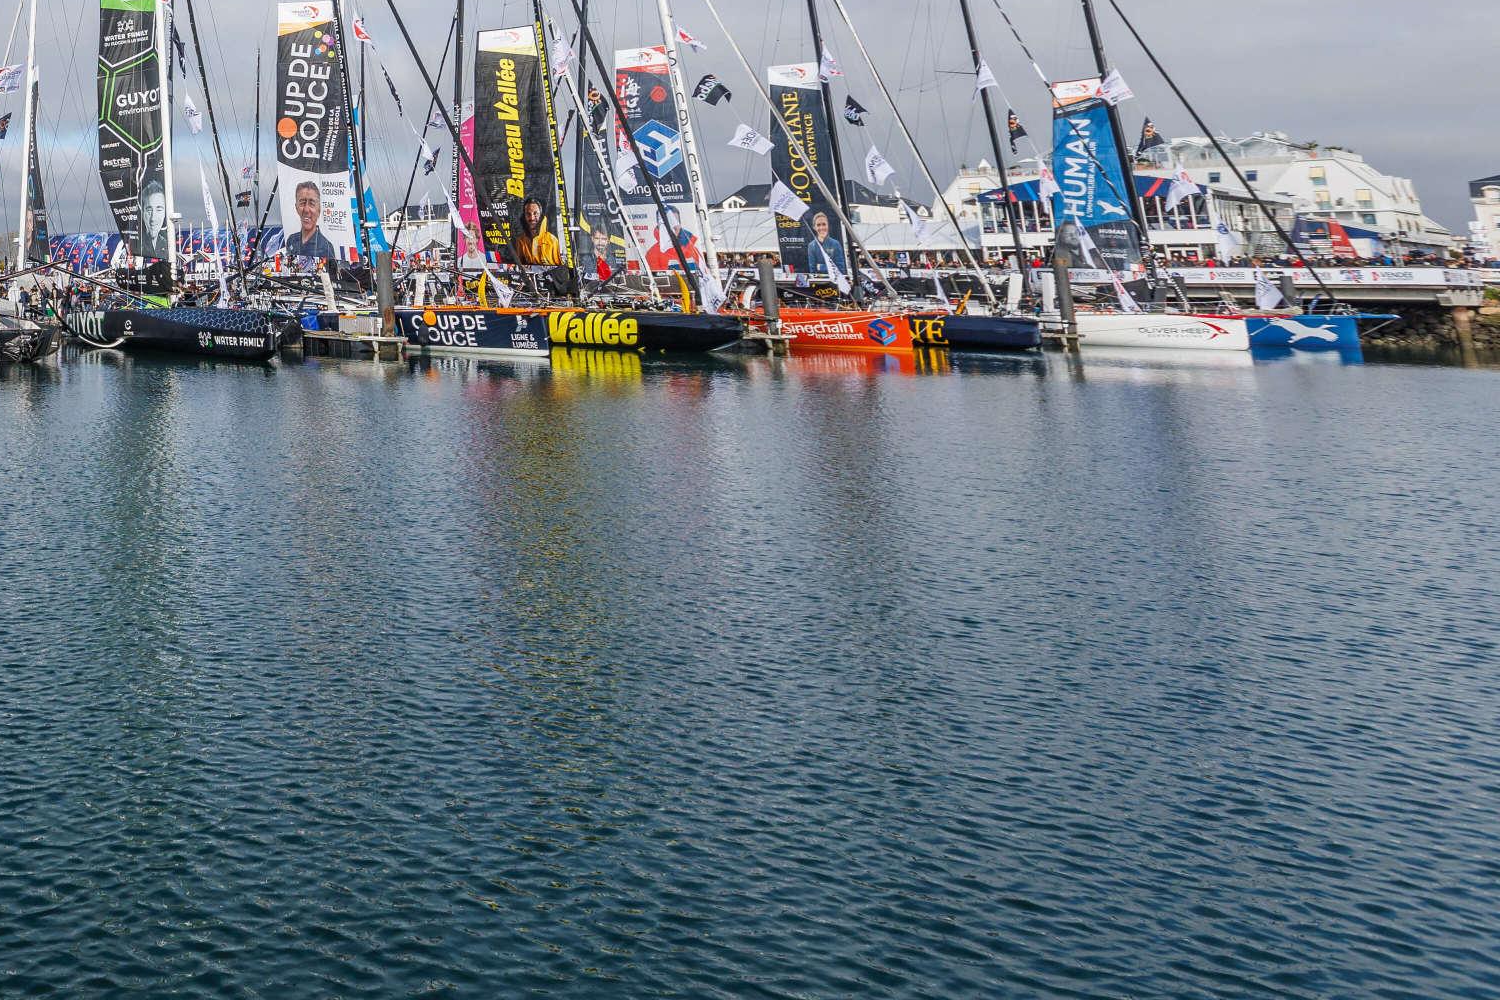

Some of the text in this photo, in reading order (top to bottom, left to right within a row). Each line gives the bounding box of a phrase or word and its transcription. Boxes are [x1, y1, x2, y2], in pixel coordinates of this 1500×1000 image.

[104, 34, 126, 42] WATER
[288, 43, 312, 78] DE
[299, 65, 331, 159] POUCE
[493, 58, 525, 199] Bureau Vallée
[1063, 118, 1092, 217] HUMAN
[322, 181, 347, 189] MANUEL
[463, 314, 488, 331] DE
[549, 311, 638, 346] Vallée
[783, 321, 854, 338] Singchain
[1138, 327, 1178, 335] OLIVER
[214, 336, 265, 348] WATER FAMILY
[415, 328, 478, 347] OUCE
[511, 334, 528, 342] LIGNE
[815, 330, 864, 341] Investment
[512, 340, 539, 350] LUMIÈRE
